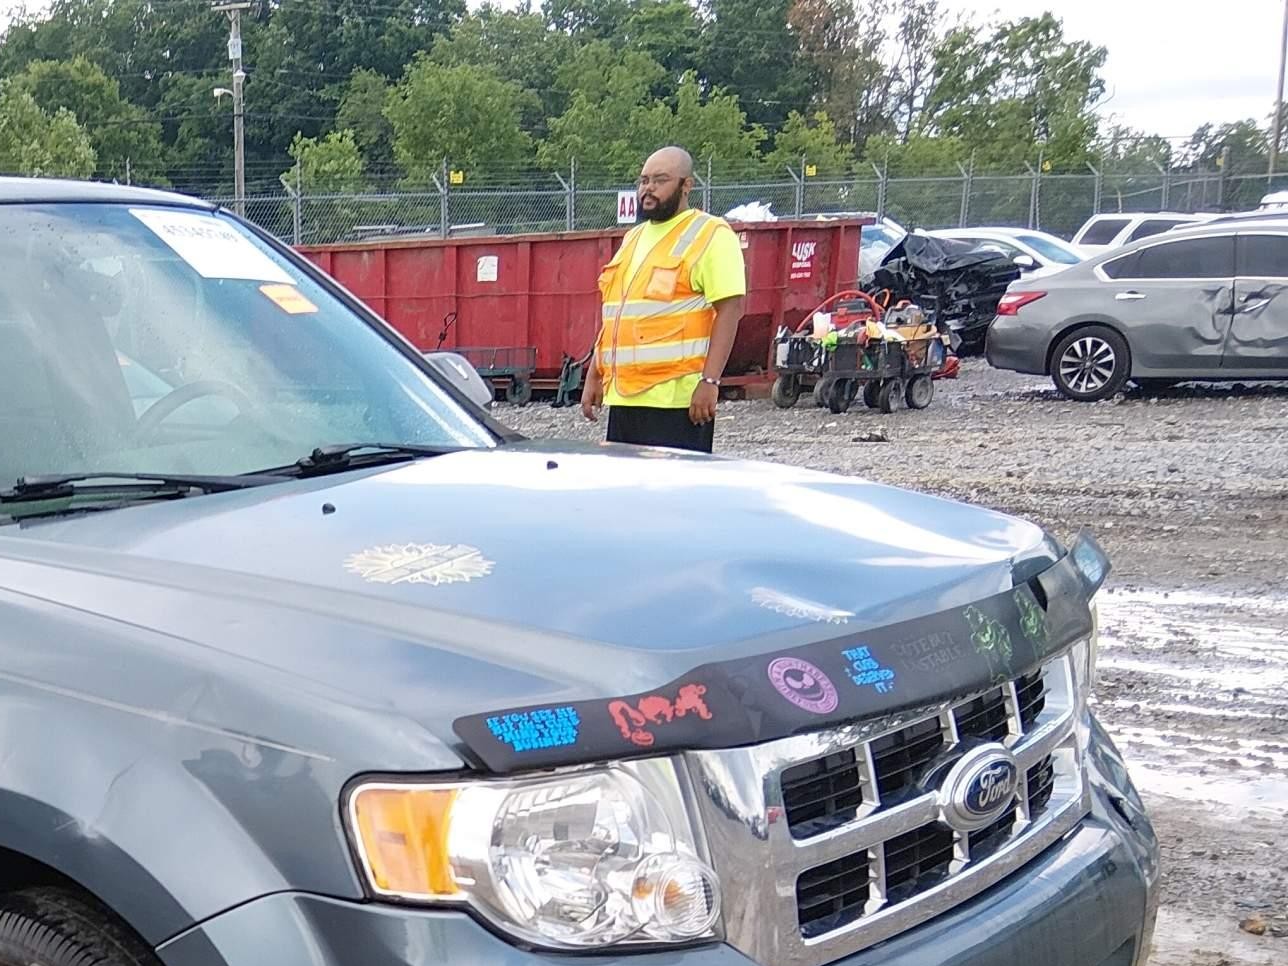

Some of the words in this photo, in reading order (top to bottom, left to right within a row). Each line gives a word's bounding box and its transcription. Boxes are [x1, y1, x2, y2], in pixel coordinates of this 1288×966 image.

[619, 196, 636, 218] AA
[792, 242, 817, 261] LUSK
[841, 646, 870, 661] THAT
[502, 712, 528, 726] YOU
[530, 709, 556, 722] SEE
[513, 735, 576, 752] BUSINESS
[978, 766, 1011, 808] Ford
